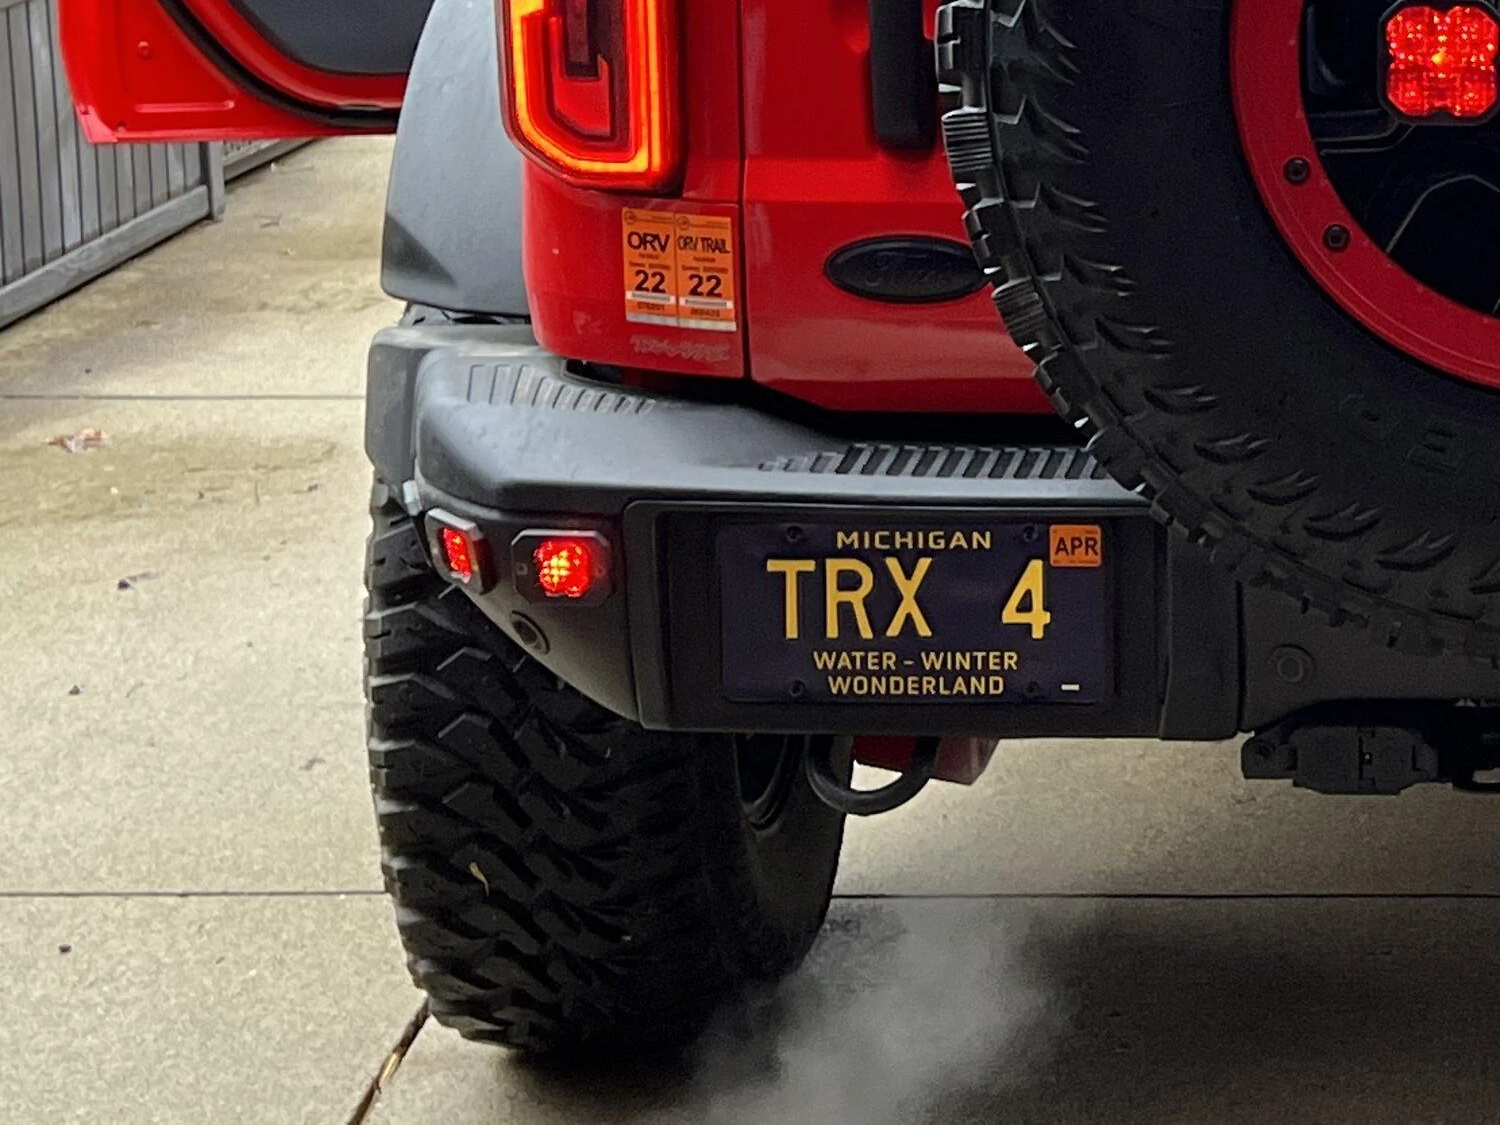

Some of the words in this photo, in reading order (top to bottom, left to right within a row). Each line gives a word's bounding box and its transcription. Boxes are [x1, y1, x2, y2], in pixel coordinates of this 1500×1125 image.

[627, 231, 671, 254] ORV
[634, 269, 667, 294] 22
[688, 273, 722, 298] 22
[836, 531, 992, 550] MICHIGAN
[1054, 536, 1099, 557] APR
[766, 557, 933, 640] TRX
[1001, 558, 1051, 640] 4
[813, 651, 896, 671] WATER
[920, 651, 1018, 671] WINTER
[827, 676, 1005, 695] WONDERLAND
